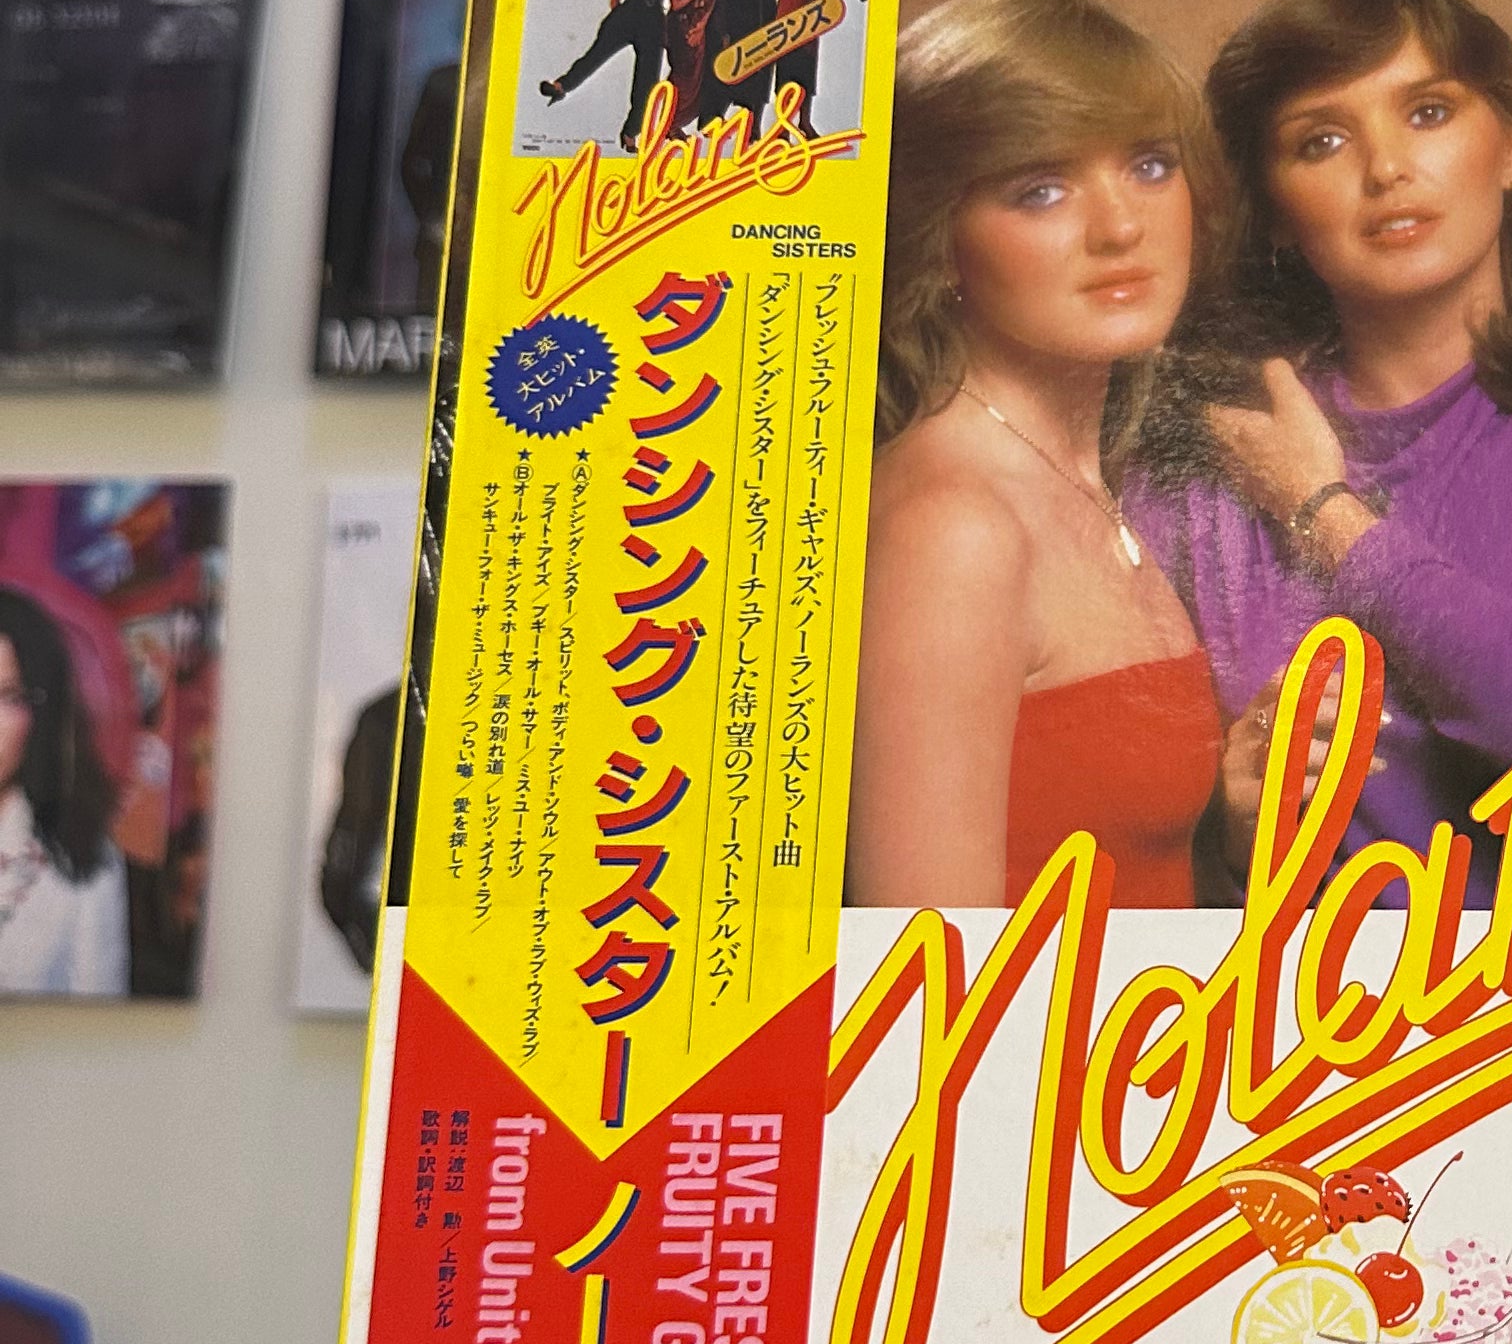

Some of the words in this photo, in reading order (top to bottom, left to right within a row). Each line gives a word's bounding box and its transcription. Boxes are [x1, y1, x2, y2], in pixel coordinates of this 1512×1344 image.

[512, 80, 867, 330] Nolans
[731, 224, 821, 241] DANCING
[772, 243, 857, 259] SISTERS
[518, 334, 560, 371] 全英
[527, 368, 606, 423] アルバム
[486, 1112, 547, 1231] from
[658, 1113, 724, 1303] FRUITY
[722, 1113, 784, 1225] FIVE
